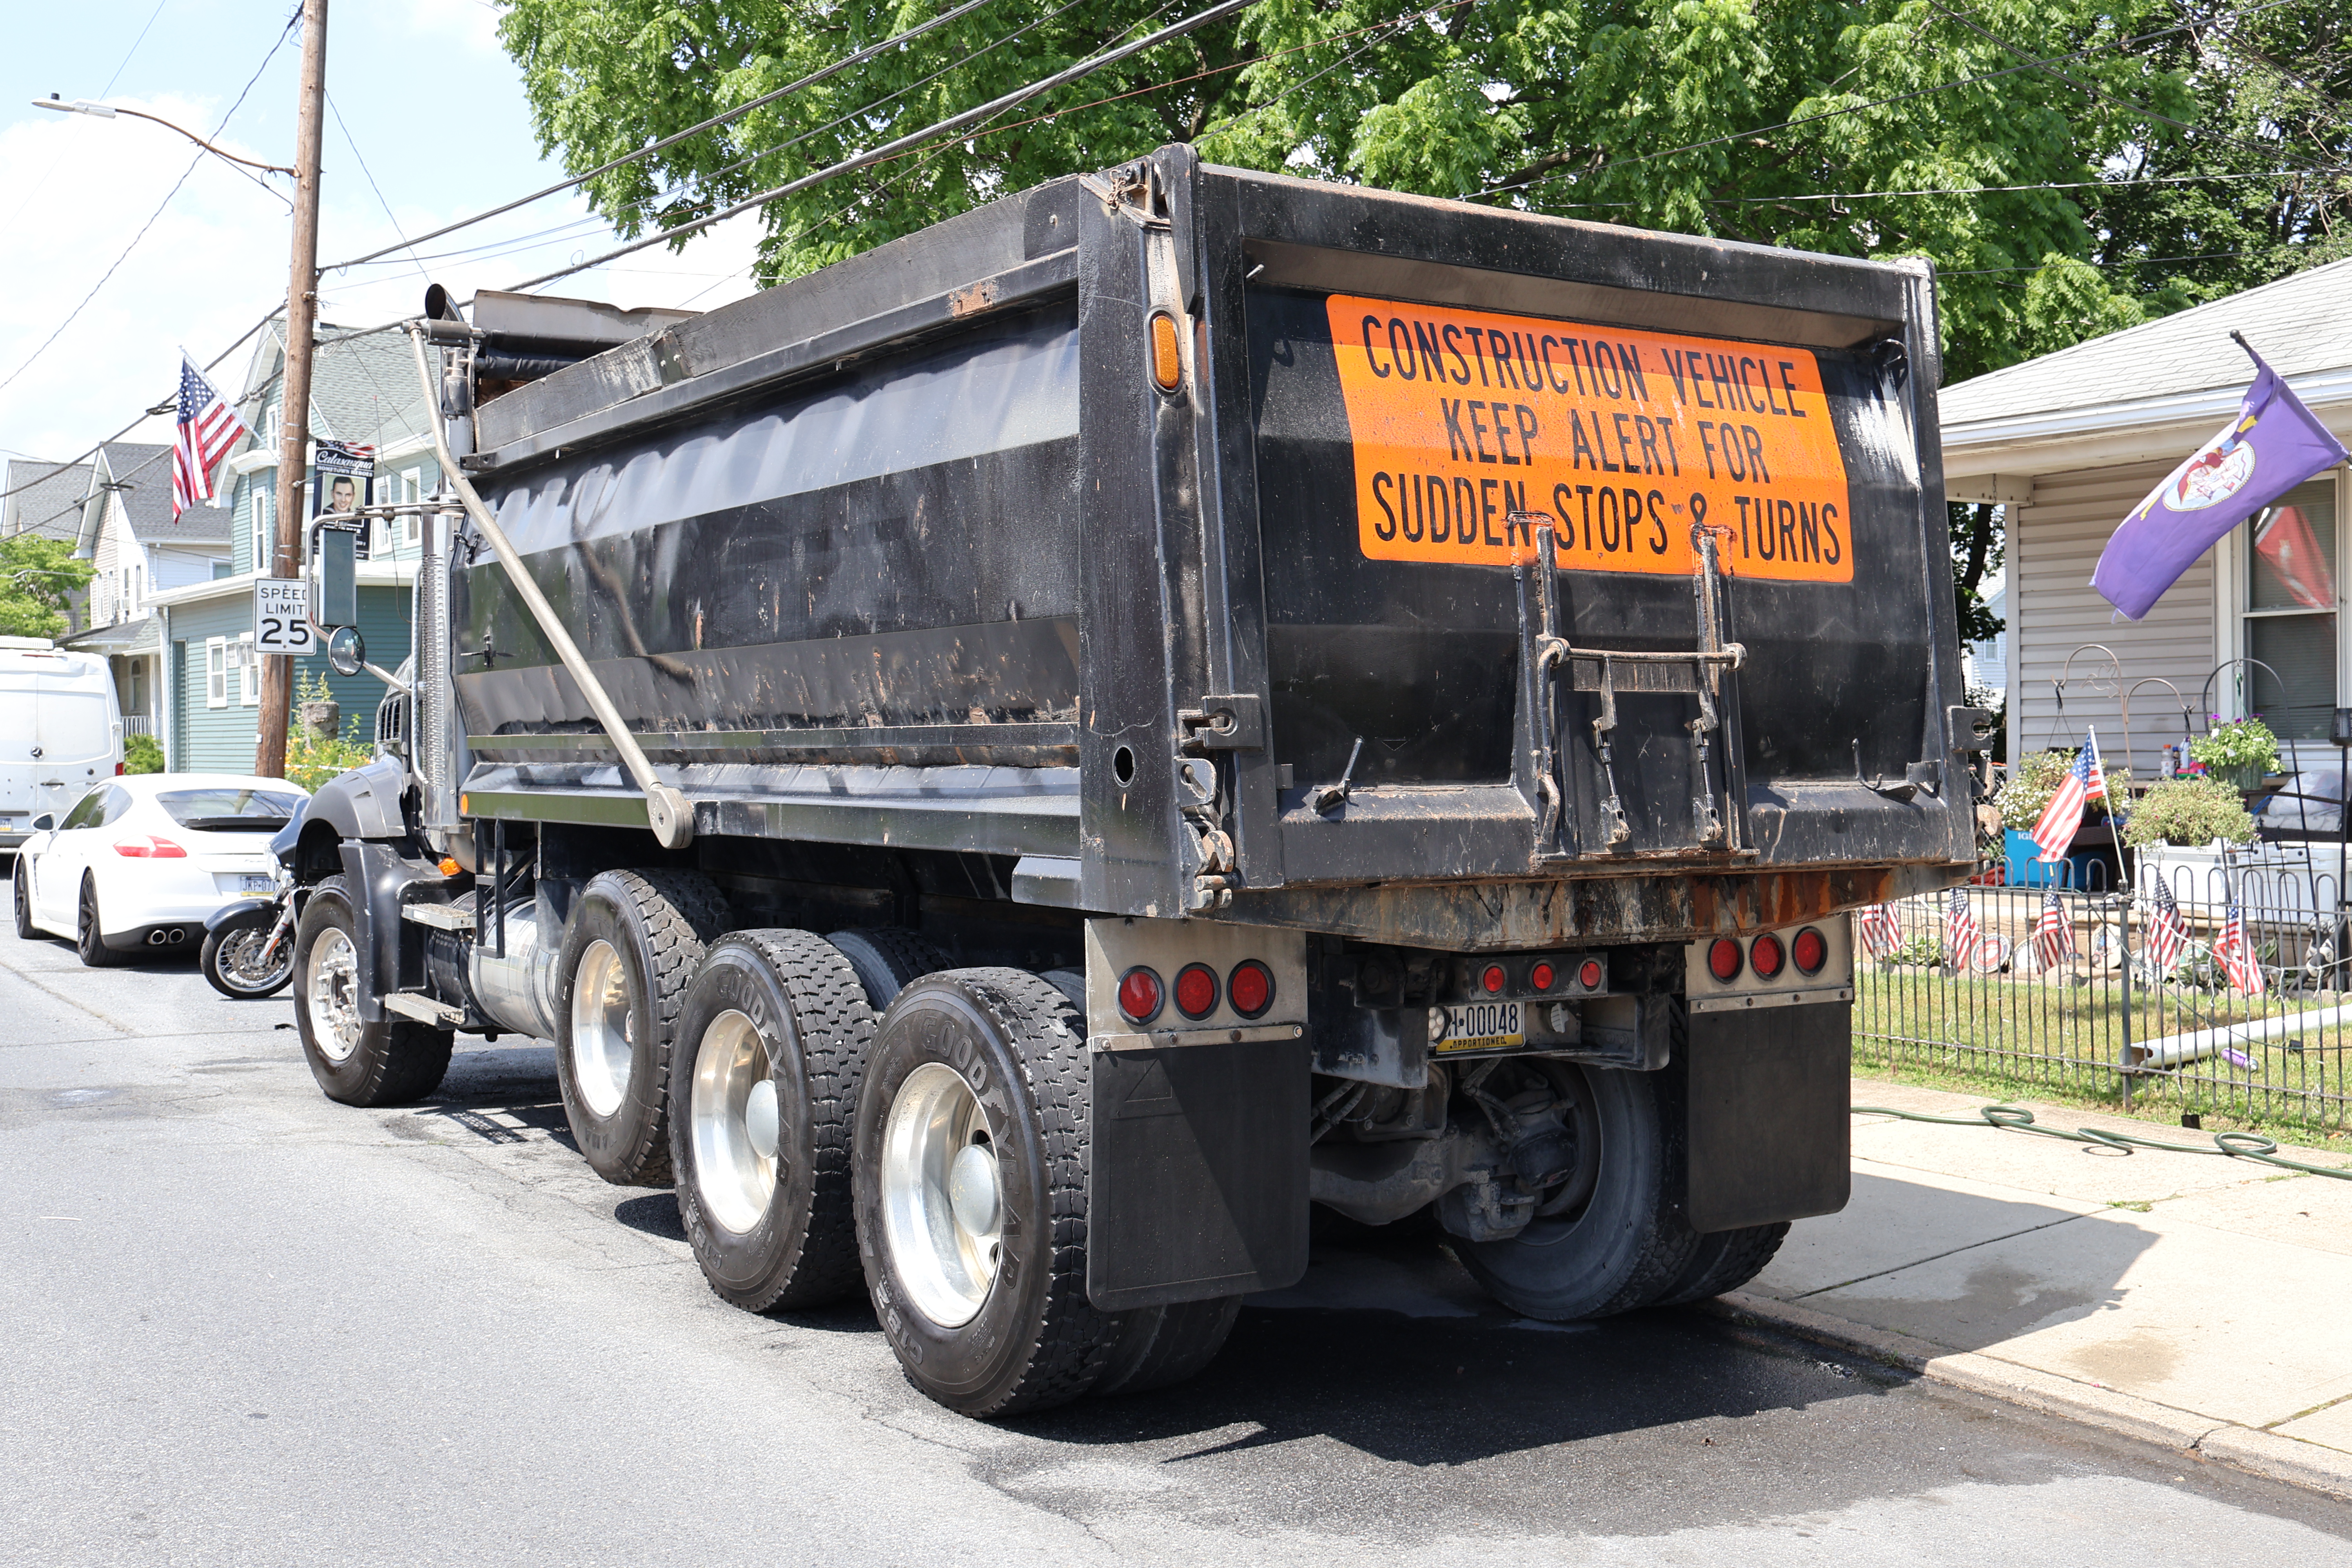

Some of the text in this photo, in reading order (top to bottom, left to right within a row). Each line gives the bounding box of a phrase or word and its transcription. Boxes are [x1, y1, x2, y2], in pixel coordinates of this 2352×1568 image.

[1361, 315, 1806, 418] CONSTRUCTION VEHICLE
[317, 451, 374, 470] Catasauqua
[1441, 397, 1770, 483] KEEP ALERT FOR
[317, 466, 350, 474] HOMETOWN
[1372, 471, 1839, 565] SUDDEN STOPS & TURNS
[261, 618, 309, 645] 25
[266, 603, 305, 615] LIMIT
[1453, 1036, 1505, 1049] APPORTIONED
[921, 1014, 1020, 1289] GOODYEAR
[875, 1279, 924, 1365] G182
